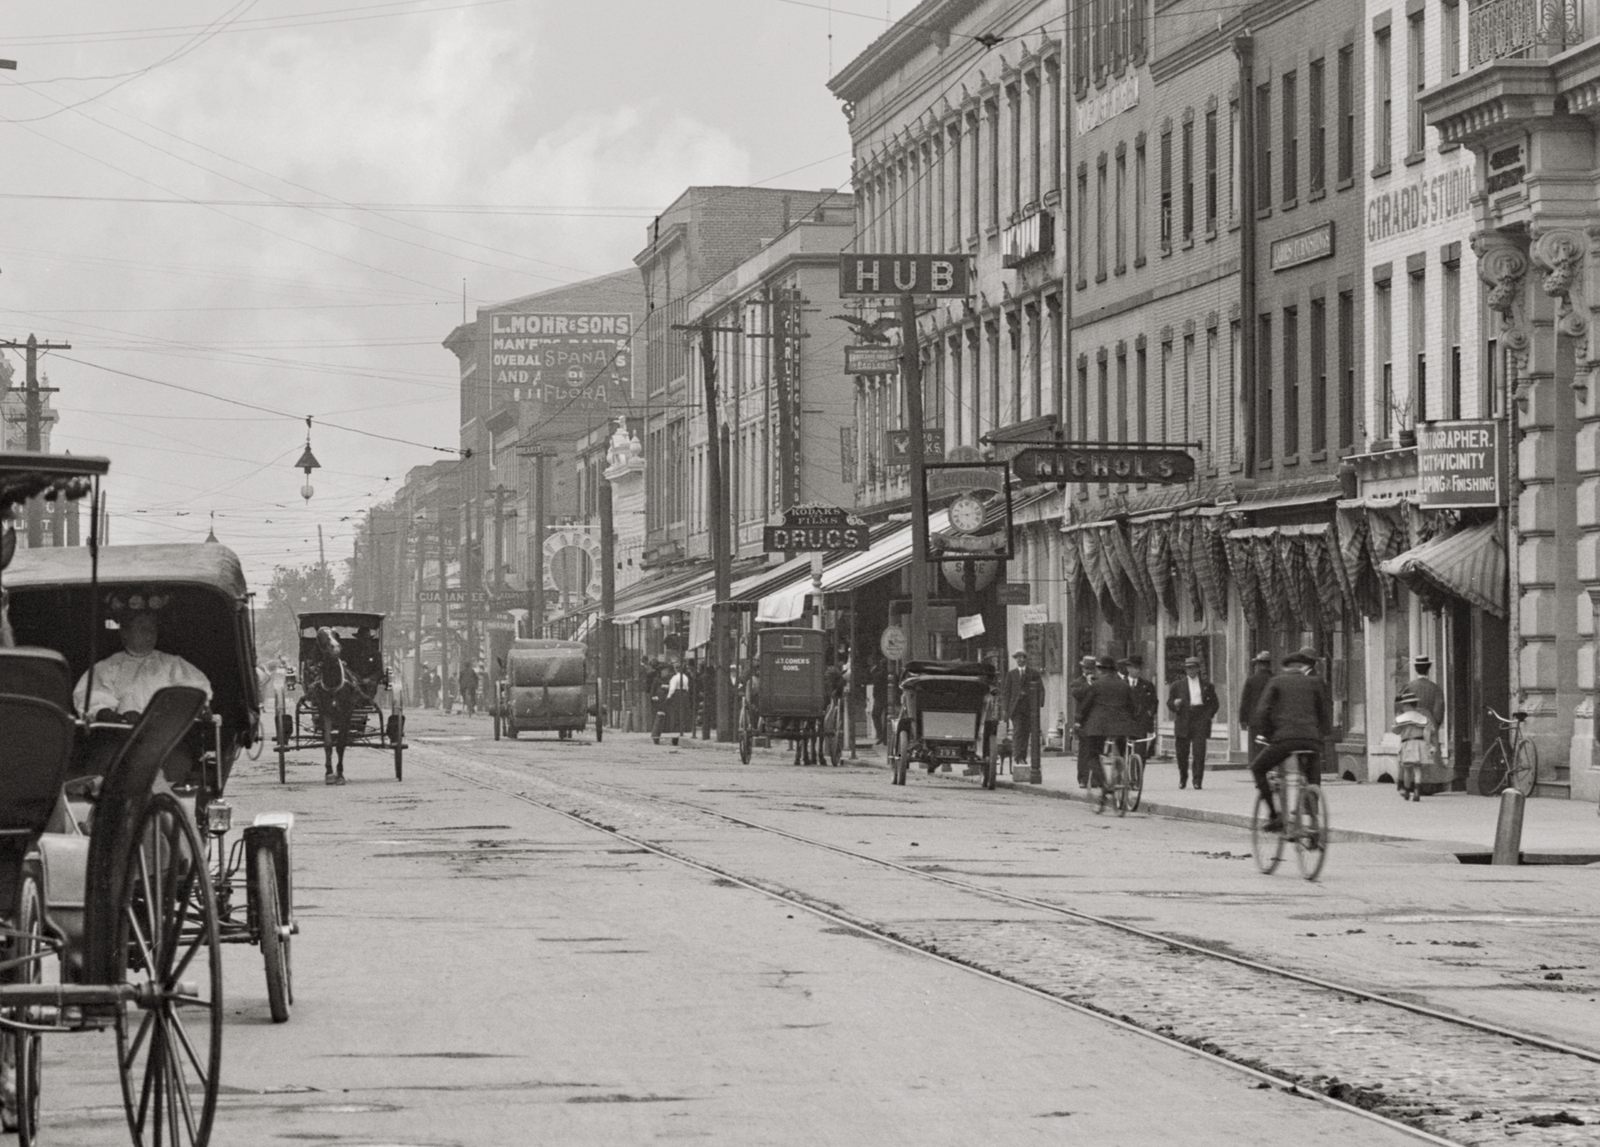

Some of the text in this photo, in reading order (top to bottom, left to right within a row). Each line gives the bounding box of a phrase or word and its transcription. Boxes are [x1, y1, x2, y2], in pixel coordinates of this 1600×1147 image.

[1367, 172, 1428, 242] GIRARD'S
[856, 260, 954, 291] HUB
[577, 316, 629, 334] SONS
[545, 350, 607, 367] SPANA
[497, 371, 529, 383] AND
[543, 384, 606, 403] FLORA
[1034, 454, 1174, 478] NICHOLS
[1440, 452, 1486, 471] VICINITY
[791, 508, 841, 516] KODAKS
[798, 517, 838, 525] FILMS
[773, 529, 859, 549] DRUGS
[420, 592, 486, 602] GUAANEE
